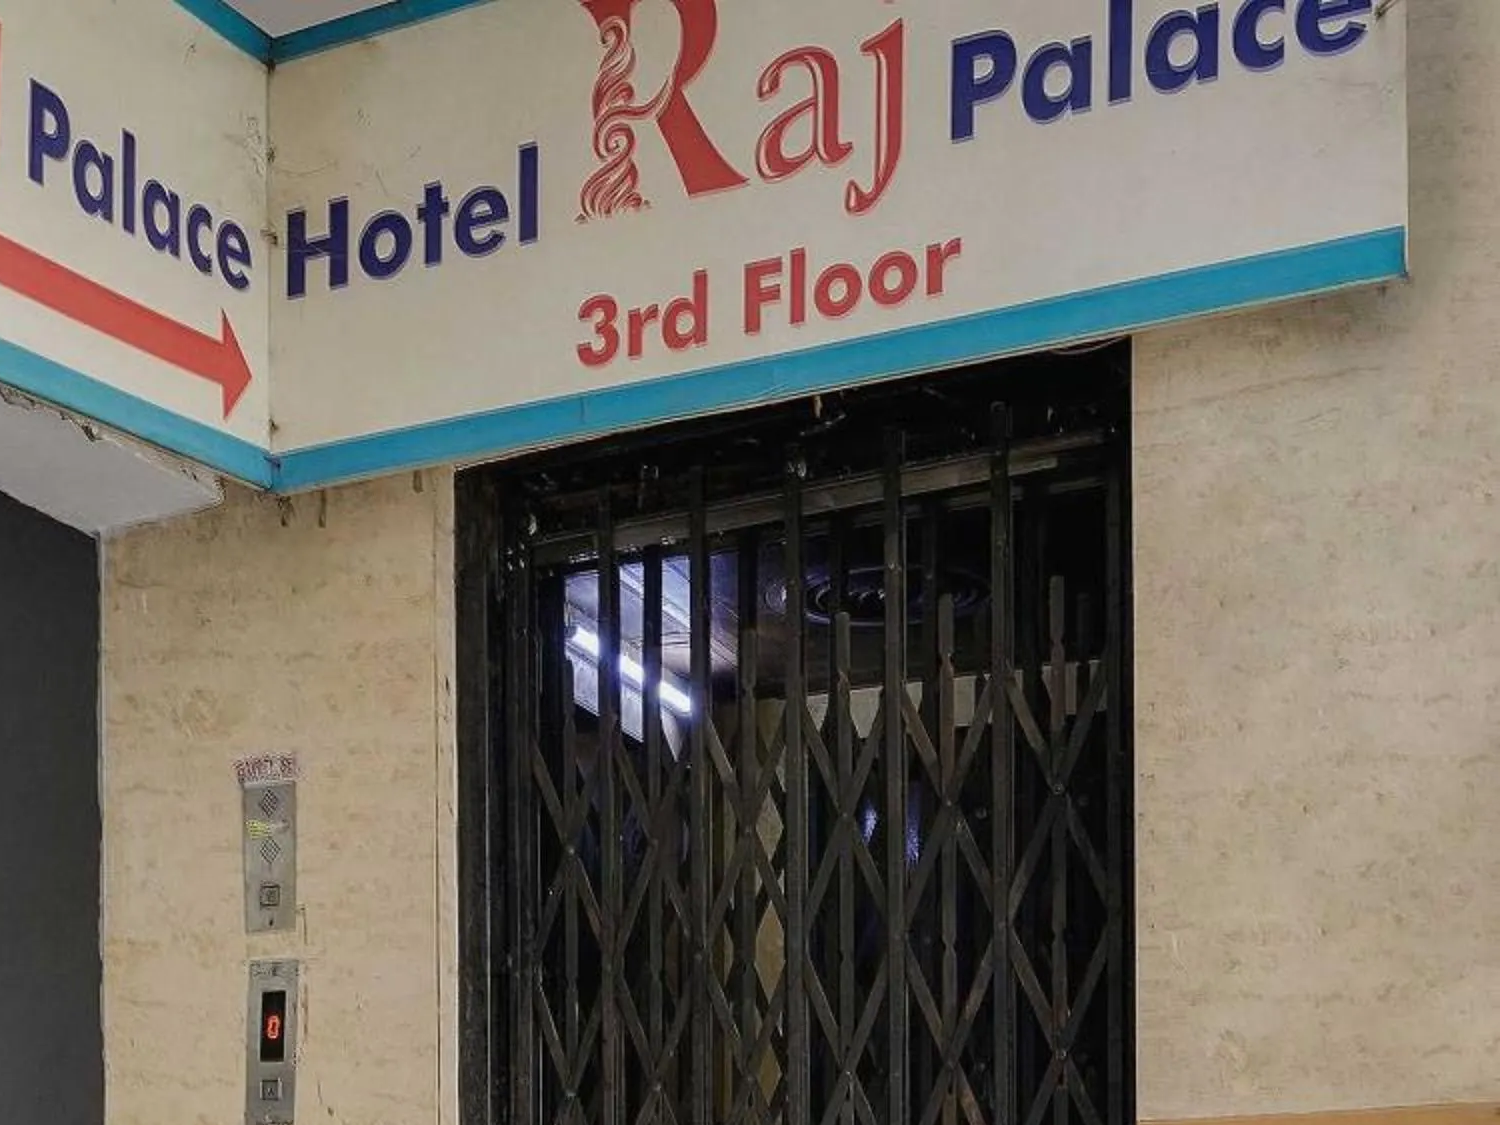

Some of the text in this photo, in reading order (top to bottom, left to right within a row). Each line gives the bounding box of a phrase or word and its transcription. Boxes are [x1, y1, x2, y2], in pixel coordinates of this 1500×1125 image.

[27, 77, 252, 291] Palace
[286, 0, 1373, 300] Hotel Raj Palace
[576, 237, 963, 368] 3rd Floor
